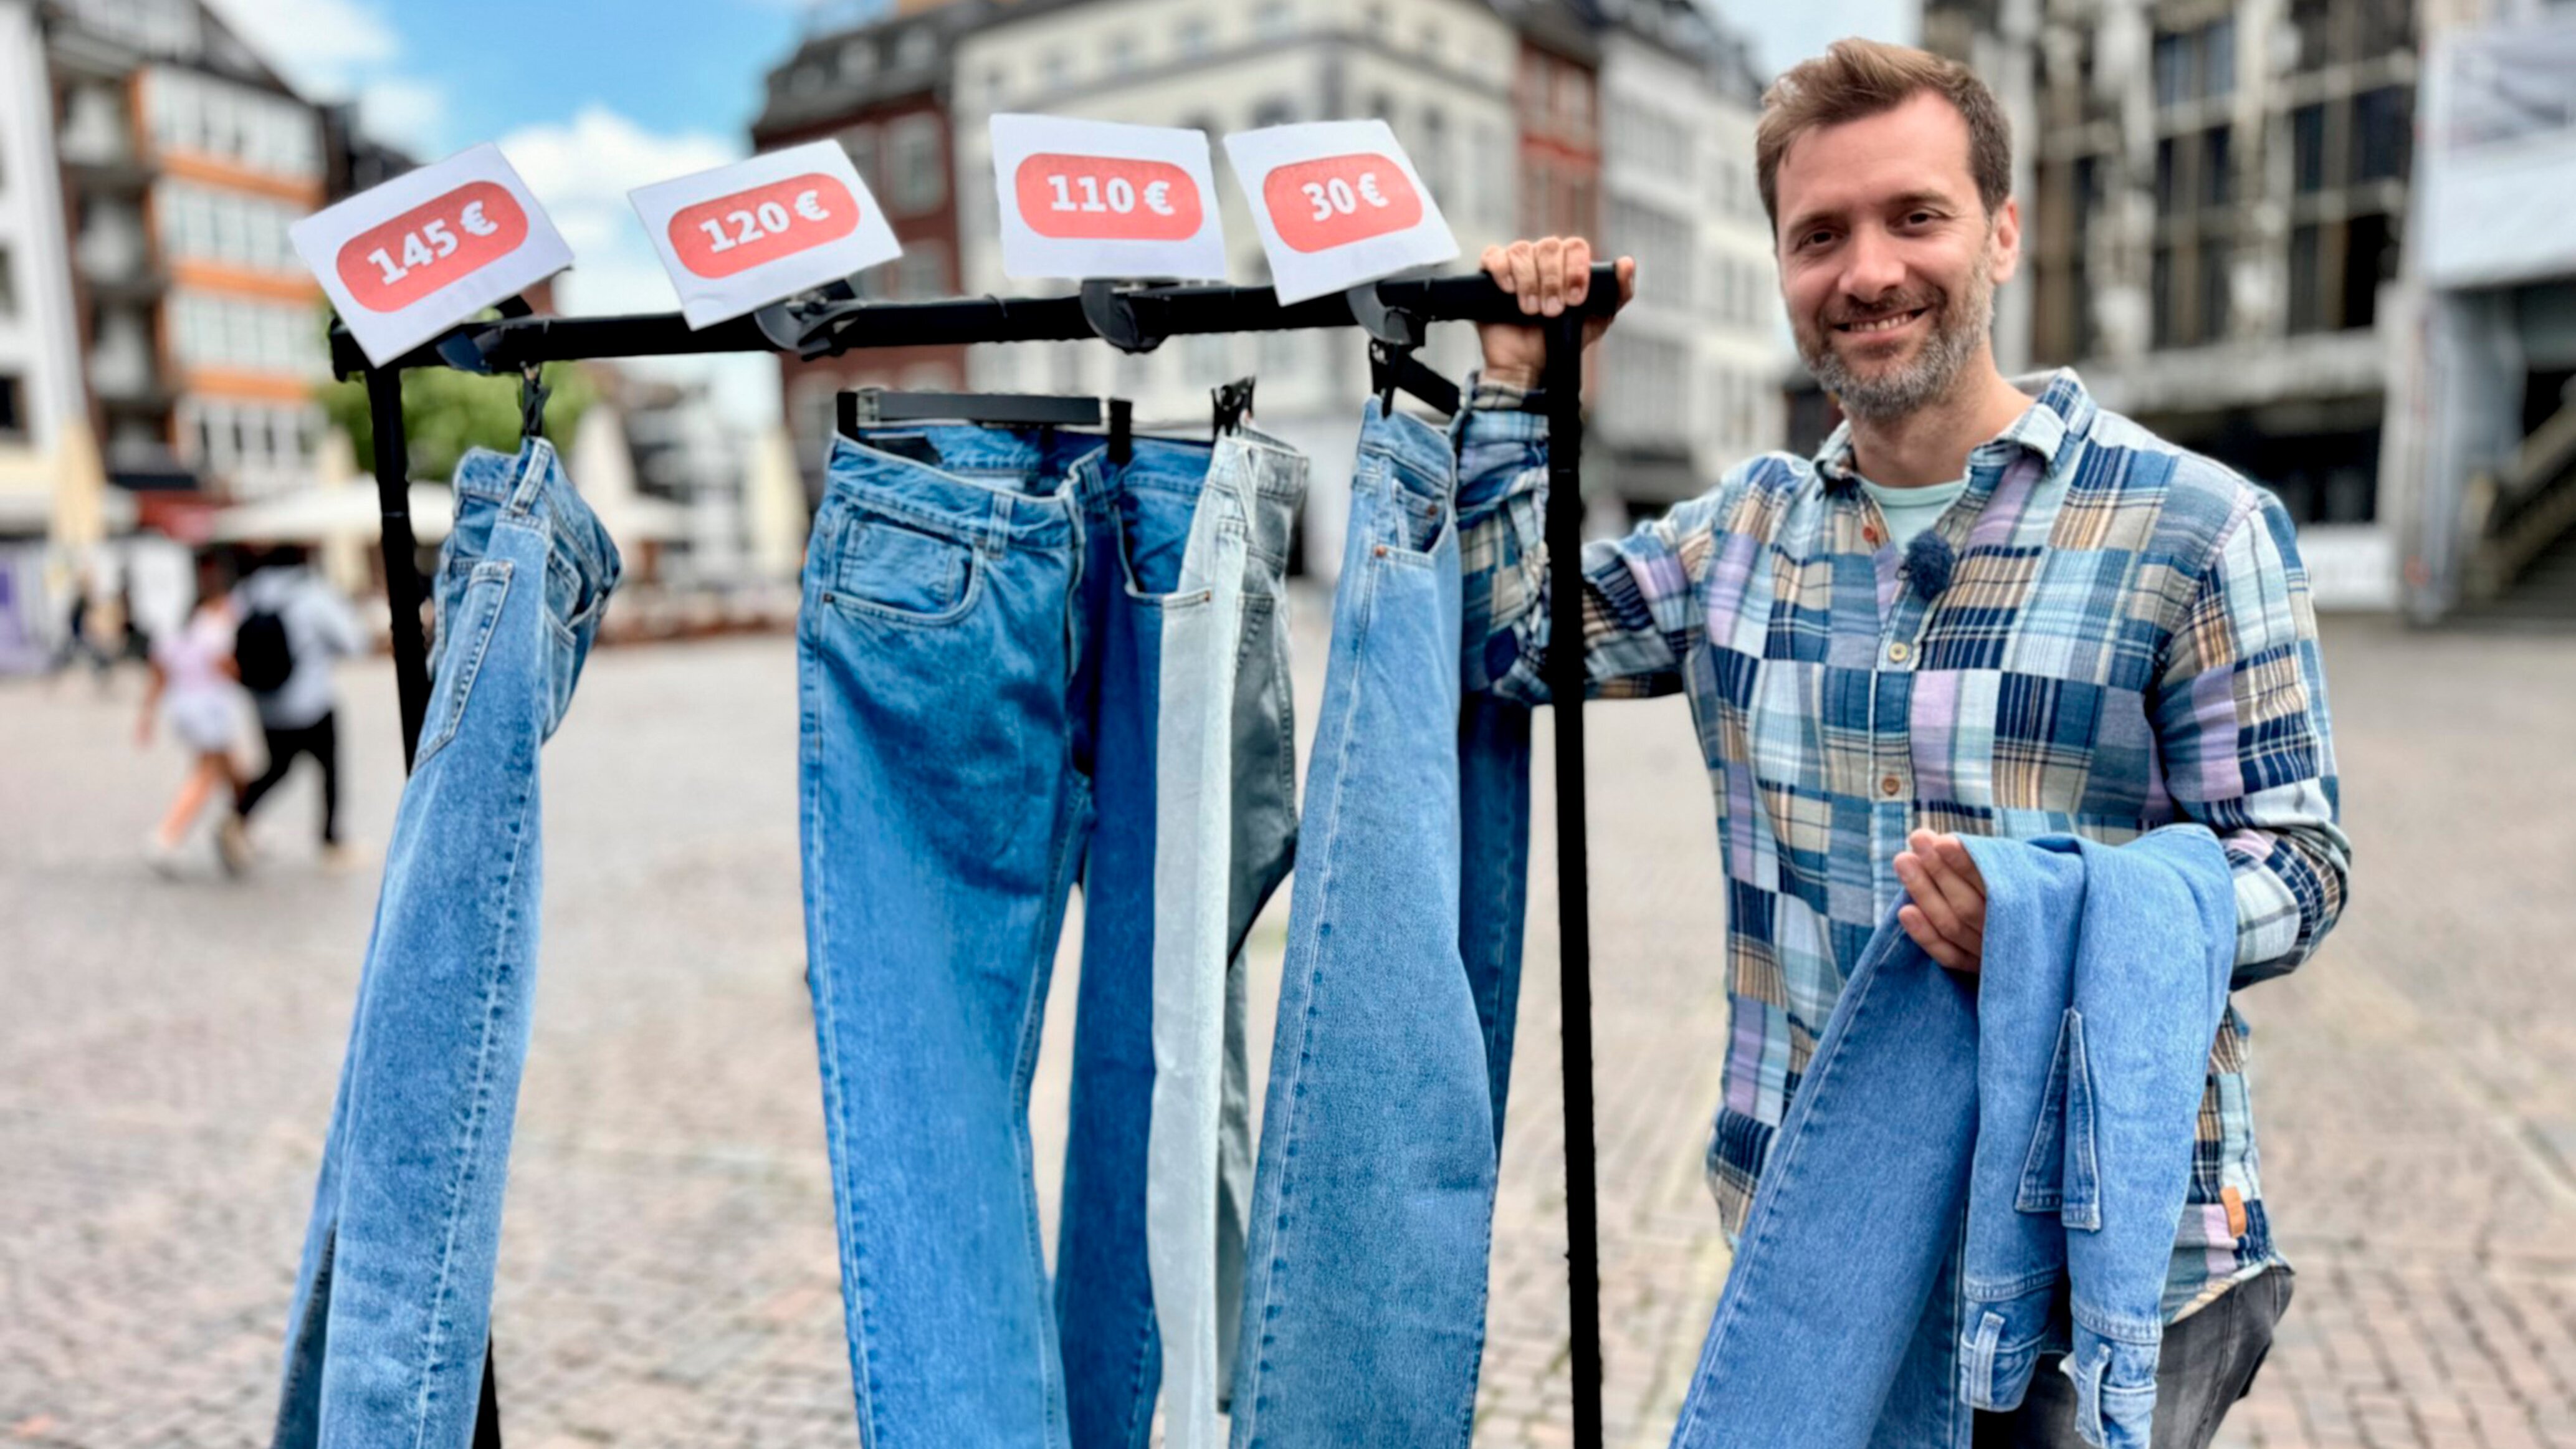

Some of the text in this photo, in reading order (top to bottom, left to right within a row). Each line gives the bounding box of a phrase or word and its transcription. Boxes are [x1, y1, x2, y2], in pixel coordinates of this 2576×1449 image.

[1047, 175, 1136, 214] 110
[1301, 176, 1358, 222] 30
[699, 201, 791, 253] 120
[368, 219, 458, 285] 145
